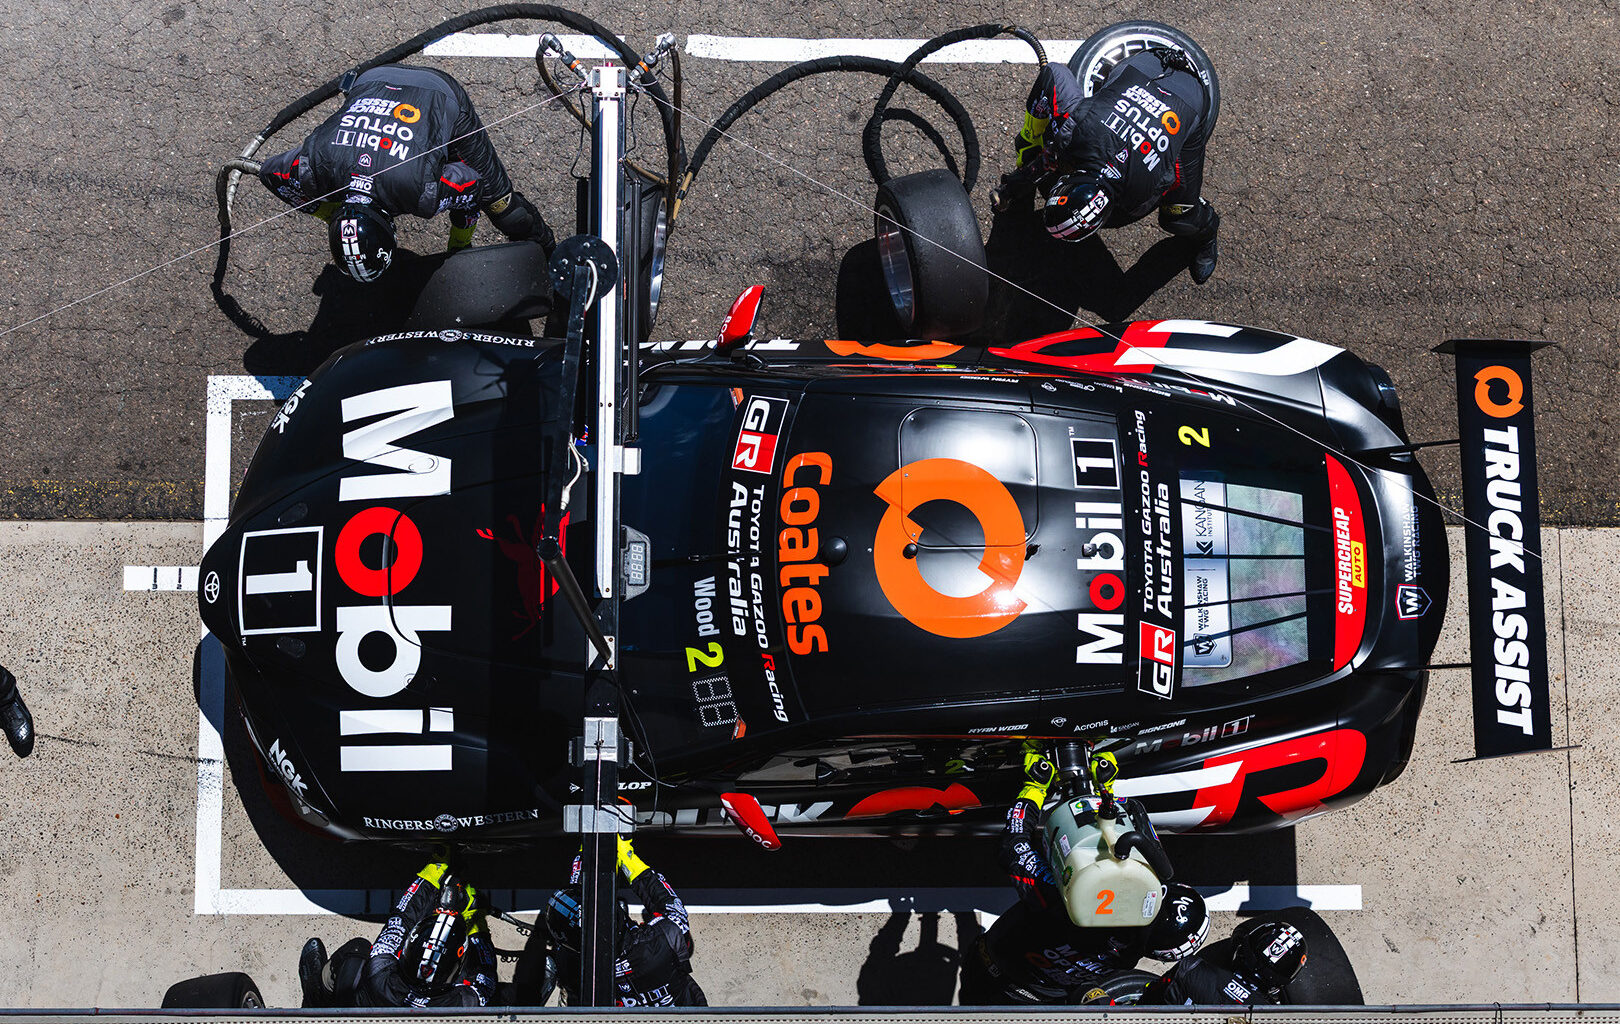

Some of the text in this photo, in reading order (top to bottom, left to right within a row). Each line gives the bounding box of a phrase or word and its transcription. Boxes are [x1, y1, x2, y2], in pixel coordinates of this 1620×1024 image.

[346, 104, 393, 116] TRUCK
[354, 98, 400, 109] ASSIST
[1121, 89, 1165, 118] TRUCK
[340, 115, 413, 141] OPTUS
[1114, 99, 1169, 152] OPTUS
[356, 132, 409, 160] Mobil
[350, 180, 372, 191] OMP
[364, 329, 439, 346] WESTERN
[462, 332, 536, 348] RINGERS
[271, 379, 312, 434] NGK
[1178, 425, 1210, 448] 2
[1134, 410, 1154, 612] TOYOTA GAZOO Racing
[779, 451, 833, 656] Coates
[1154, 482, 1172, 619] Australia
[1403, 504, 1413, 582] WALKINSHAW
[726, 481, 749, 637] Australia
[1333, 507, 1353, 615] SUPERCHEAP
[1354, 546, 1362, 583] AUTO
[335, 380, 454, 771] Mobil
[1075, 502, 1125, 664] Mobil
[1483, 425, 1534, 736] TRUCK ASSIST
[749, 484, 789, 722] TOYOTA GAZOO Racing
[1196, 575, 1204, 632] WALKNSHAW
[686, 576, 725, 673] Wood 2
[968, 723, 1029, 734] RYAN WOOD
[1073, 719, 1109, 732] Acronis
[1135, 725, 1218, 755] Mobil
[1138, 719, 1187, 735] SIGNZONE
[269, 739, 308, 797] NGK
[363, 817, 434, 831] RINGERS
[456, 809, 539, 827] WESTERN
[745, 827, 772, 849] BOC
[1095, 889, 1115, 915] 2
[1227, 981, 1249, 1001] OMP
